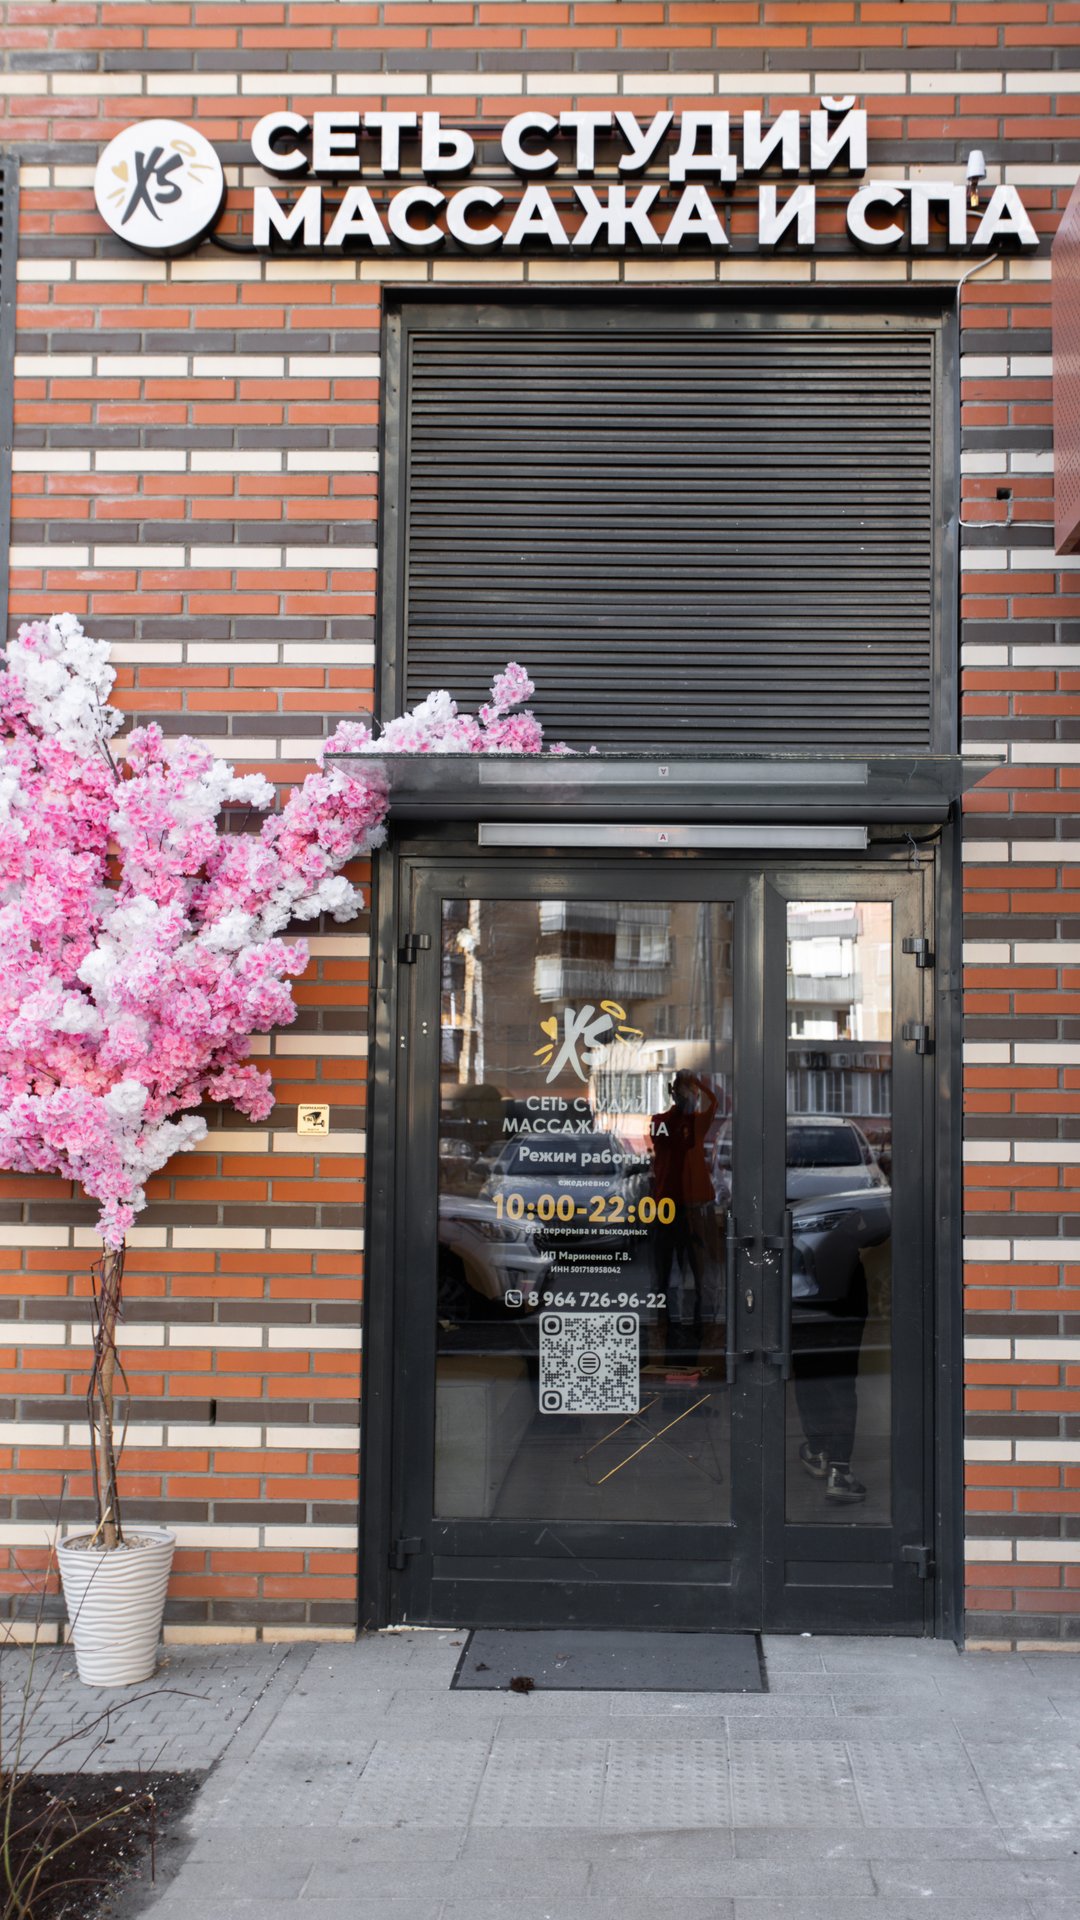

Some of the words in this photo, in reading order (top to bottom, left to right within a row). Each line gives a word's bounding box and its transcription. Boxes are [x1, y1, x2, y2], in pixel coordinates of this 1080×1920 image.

[250, 111, 475, 174] СЕТЬ
[501, 95, 868, 182] СТУДИЙ
[252, 185, 730, 248] МАССАЖА
[758, 185, 816, 247] И
[846, 185, 1040, 247] СПА
[526, 1096, 568, 1112] СЕТЬ
[518, 1146, 577, 1163] Режим
[580, 1148, 651, 1167] работы:
[558, 1179, 610, 1188] ежедневно
[491, 1193, 677, 1225] 10:00-22:00
[543, 1227, 590, 1236] перерыва
[598, 1227, 648, 1237] выходных
[540, 1251, 557, 1261] ИП
[558, 1251, 614, 1263] Мариненко
[615, 1252, 632, 1261] Г.В.
[550, 1266, 570, 1274] ИНН
[527, 1291, 539, 1307] 8
[543, 1291, 577, 1307] 964
[579, 1292, 667, 1309] 726-96-22
